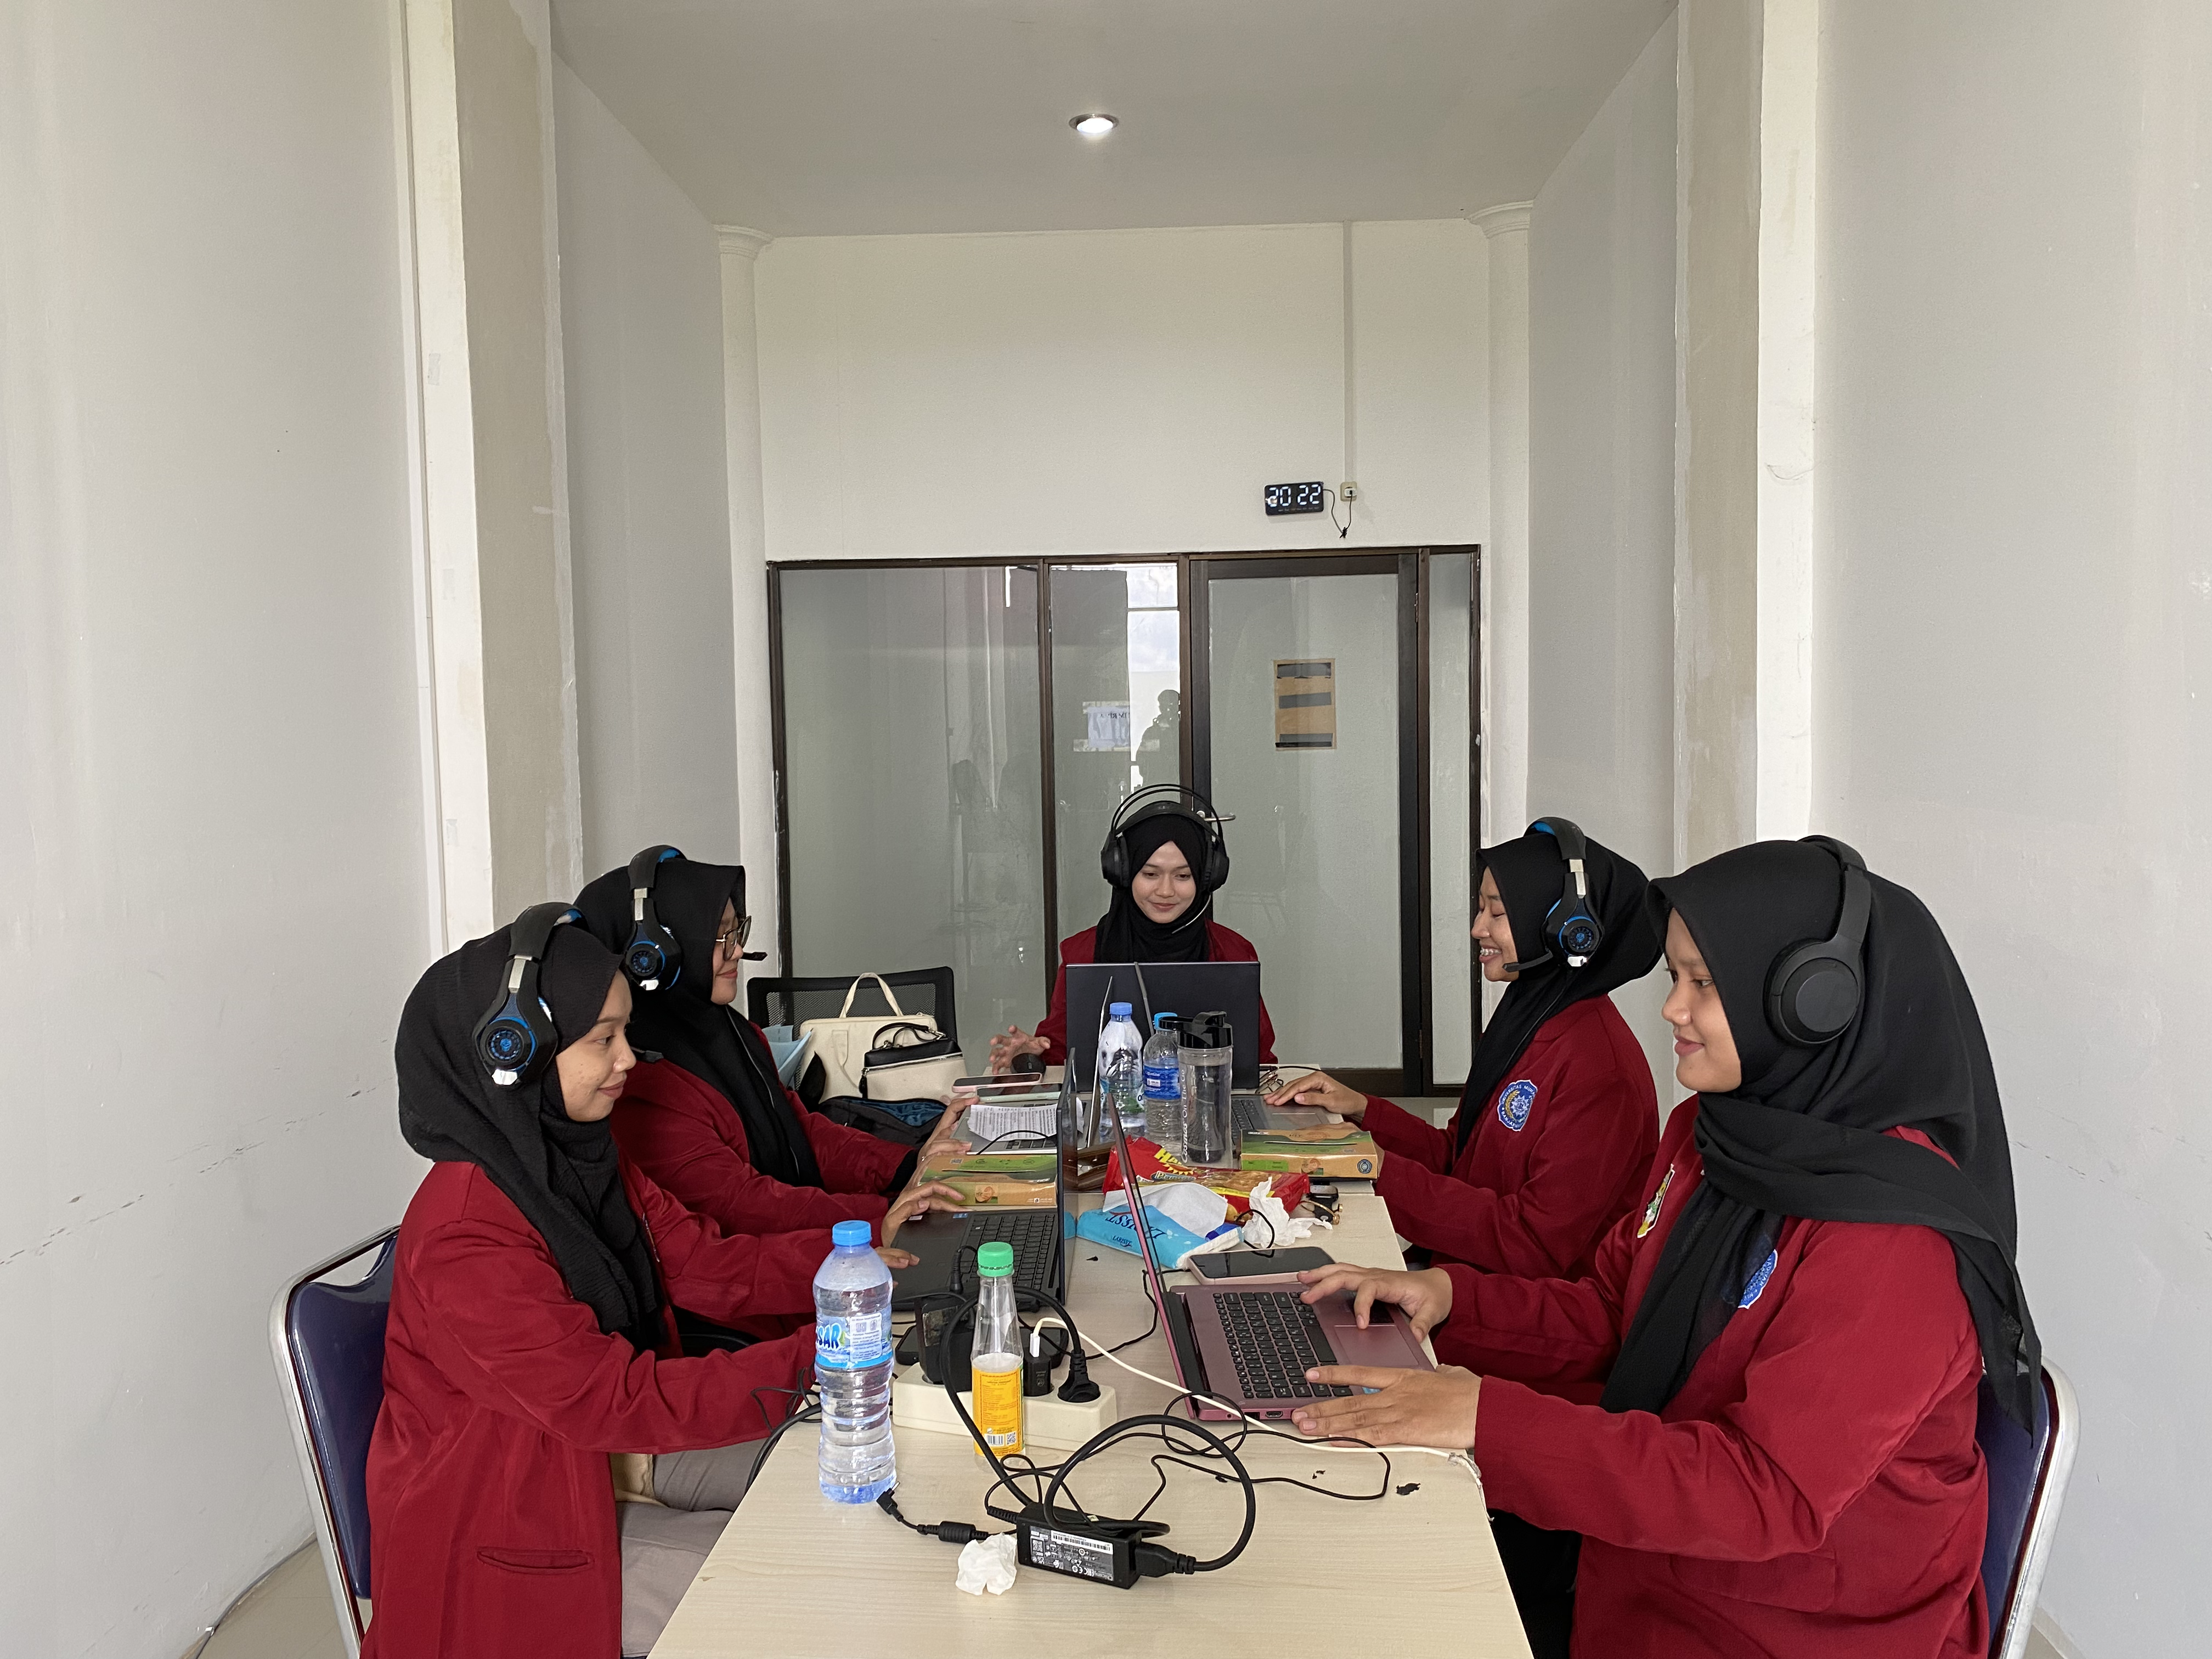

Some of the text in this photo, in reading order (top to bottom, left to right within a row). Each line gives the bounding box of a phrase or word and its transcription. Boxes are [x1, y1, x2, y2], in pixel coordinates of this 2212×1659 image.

[1181, 1069, 1185, 1082] Go
[1501, 1084, 1522, 1104] UNIVERSITAS
[1182, 1104, 1187, 1118] On
[1113, 1235, 1132, 1246] LARISST
[816, 1323, 840, 1350] SAR
